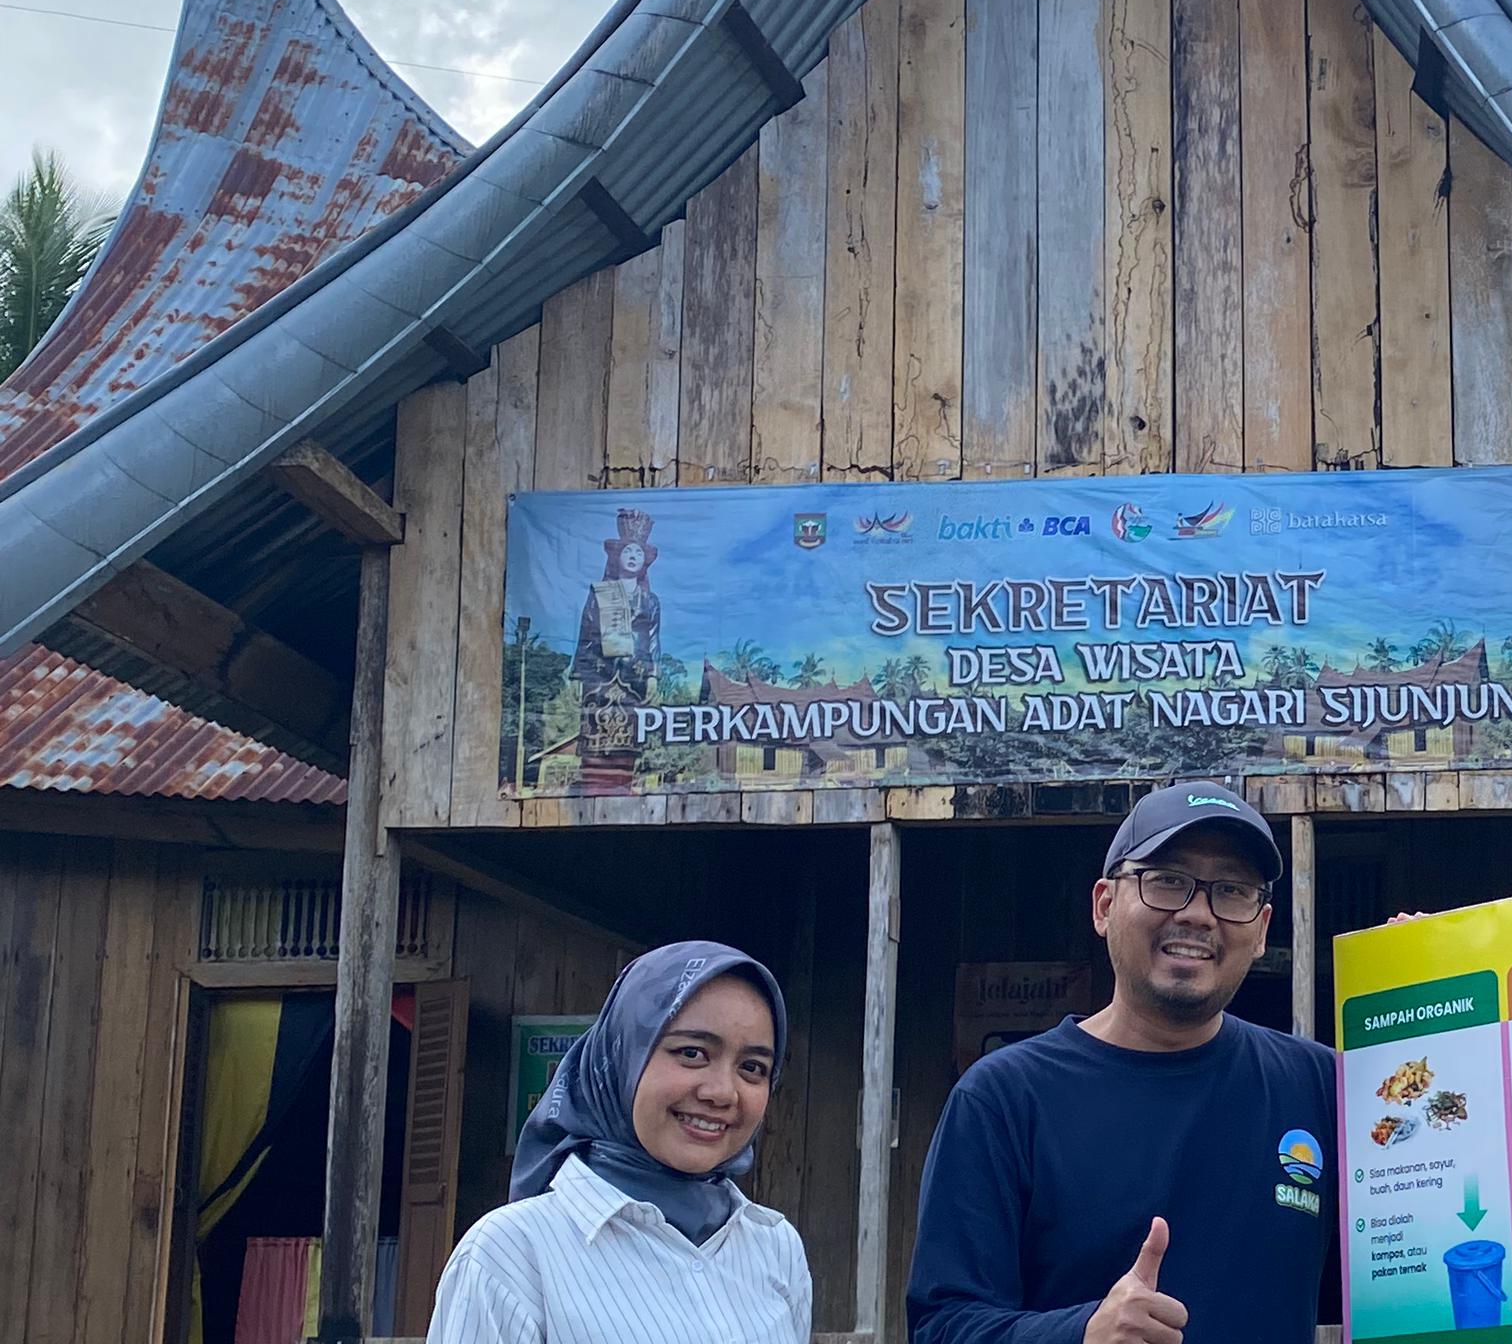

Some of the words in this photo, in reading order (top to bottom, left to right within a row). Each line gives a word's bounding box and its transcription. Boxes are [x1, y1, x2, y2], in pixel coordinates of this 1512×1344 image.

[937, 514, 1012, 539] bakti
[1042, 516, 1091, 537] BCA
[868, 569, 1327, 634] SEKRETARIAT
[947, 646, 1064, 685] DESA
[1077, 640, 1245, 681] WISATA
[634, 696, 1007, 743] PERKAMPUNGAN
[1022, 691, 1133, 732] ADAT
[1150, 688, 1305, 729] NAGARI
[1364, 1008, 1414, 1031] SAMPAH
[1417, 997, 1474, 1020] ORGANIK
